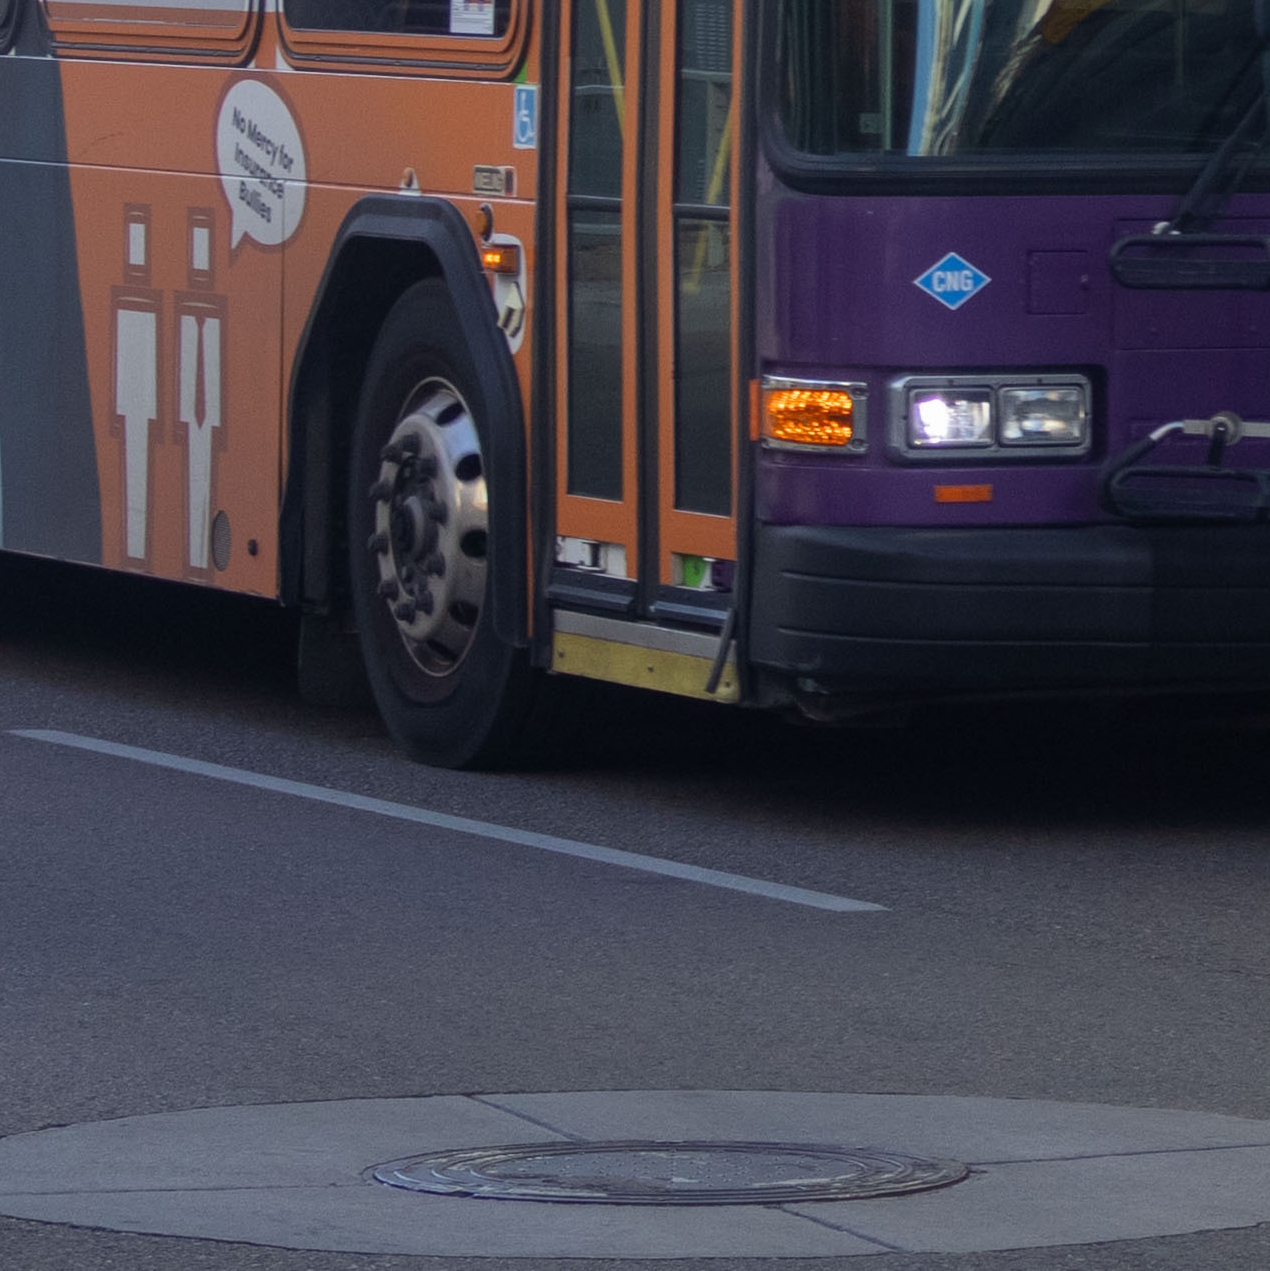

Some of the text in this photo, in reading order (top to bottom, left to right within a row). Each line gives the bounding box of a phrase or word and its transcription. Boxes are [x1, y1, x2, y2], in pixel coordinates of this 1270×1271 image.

[232, 106, 294, 173] No Mercy for
[234, 141, 285, 199] Insurance
[239, 180, 272, 223] Bullies
[932, 270, 975, 293] CNG
